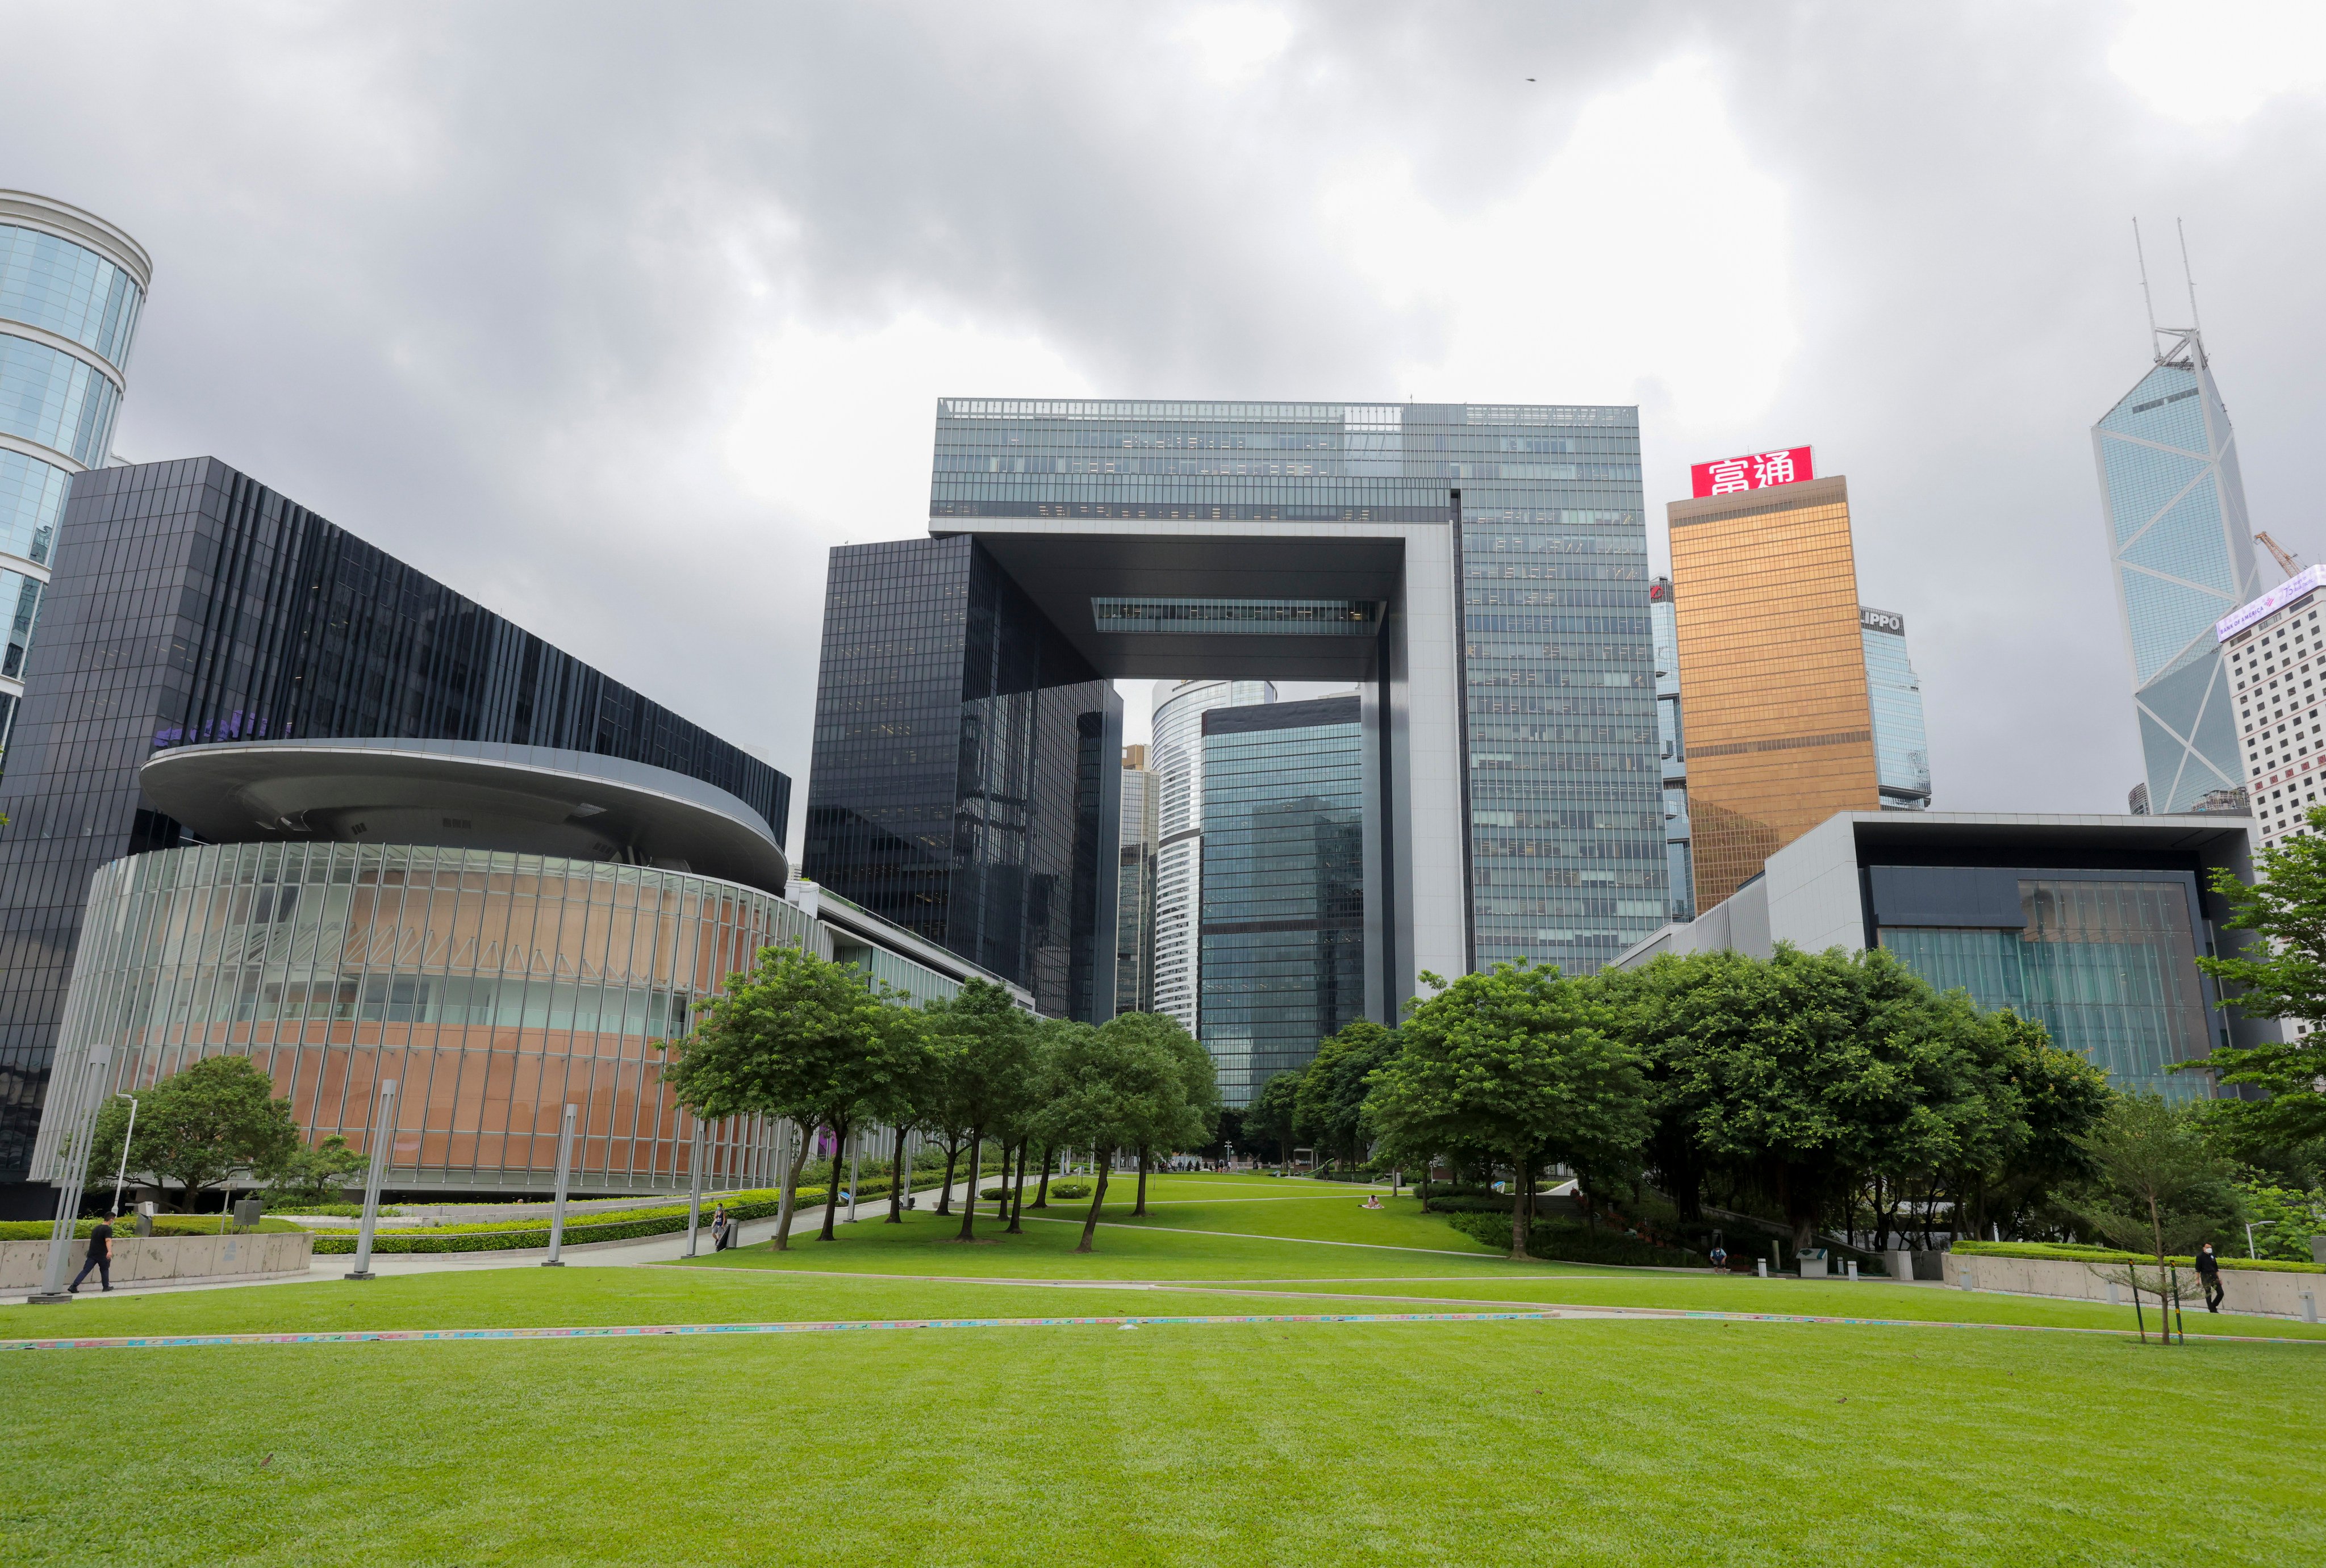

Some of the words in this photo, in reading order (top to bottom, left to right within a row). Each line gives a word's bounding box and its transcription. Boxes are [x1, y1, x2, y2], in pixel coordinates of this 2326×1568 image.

[1709, 451, 1794, 495] 富通
[2283, 586, 2293, 597] 75
[2220, 624, 2233, 634] BANK
[2241, 606, 2264, 622] AMERICA
